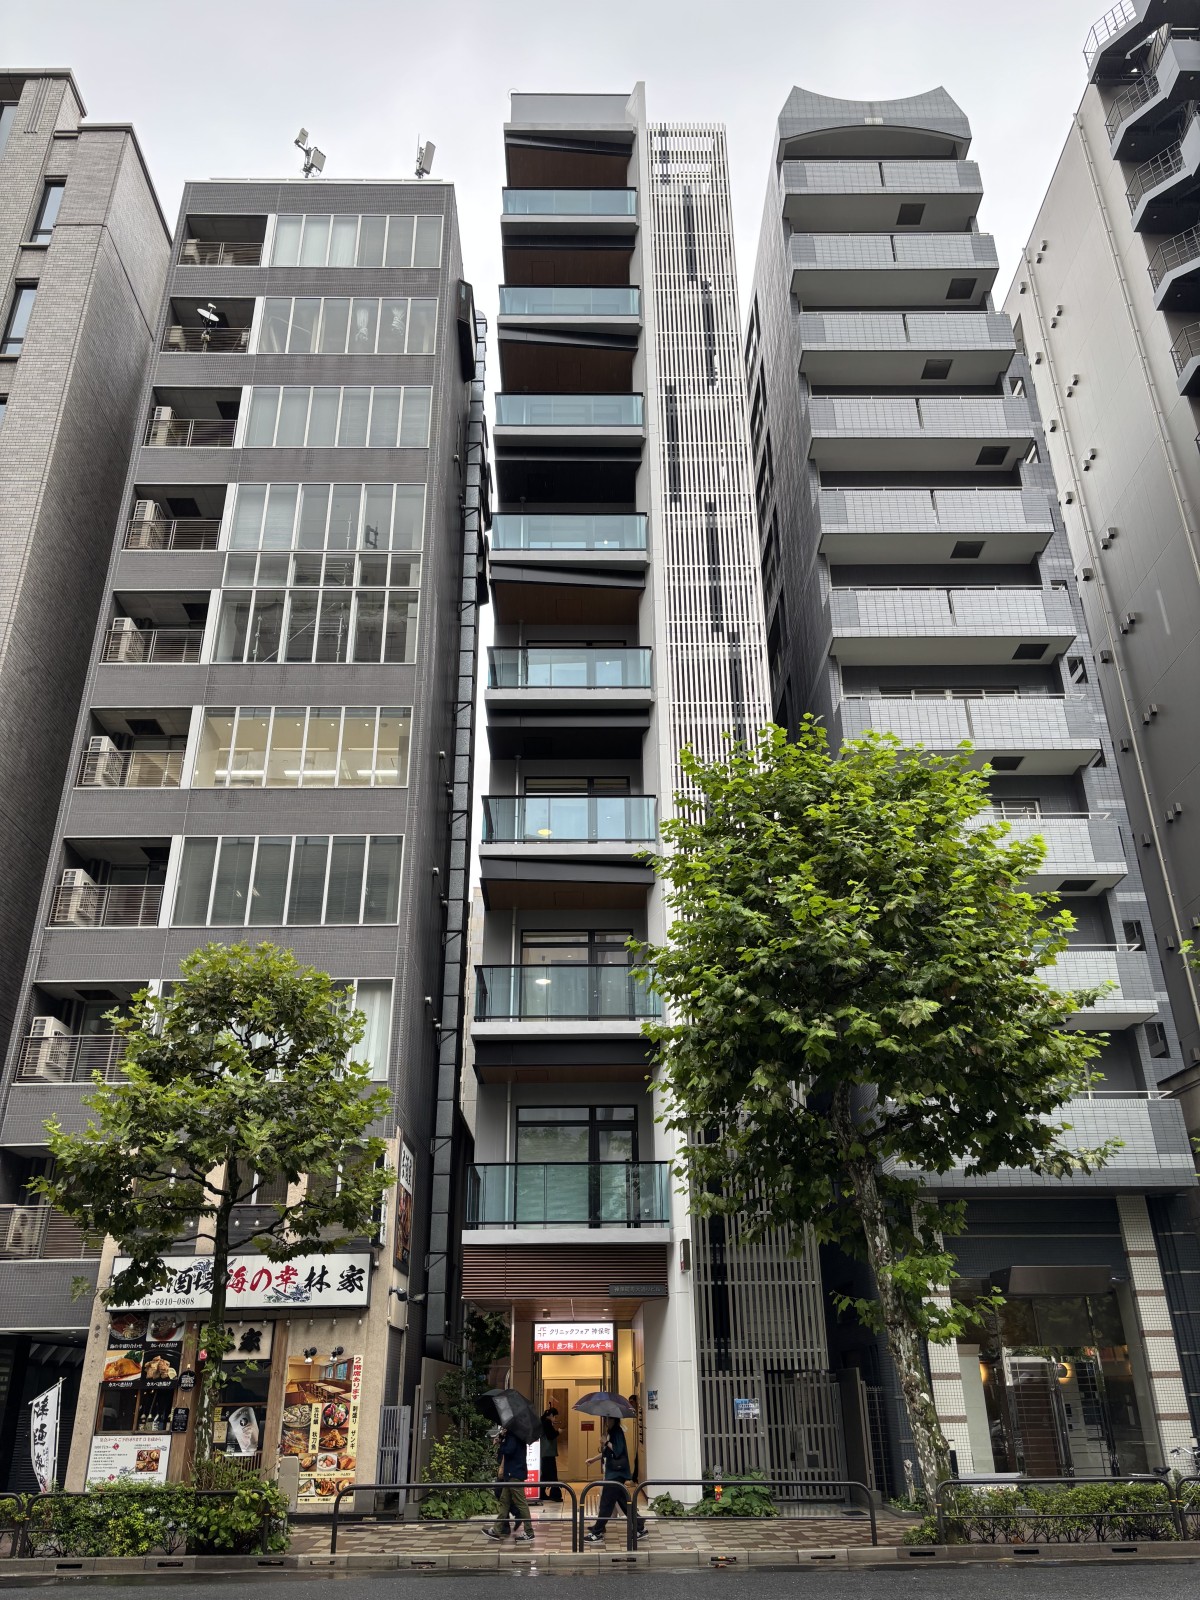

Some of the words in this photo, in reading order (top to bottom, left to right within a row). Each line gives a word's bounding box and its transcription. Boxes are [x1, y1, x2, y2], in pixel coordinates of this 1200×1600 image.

[591, 1327, 611, 1335] 神保町
[556, 1342, 573, 1350] 皮フ科
